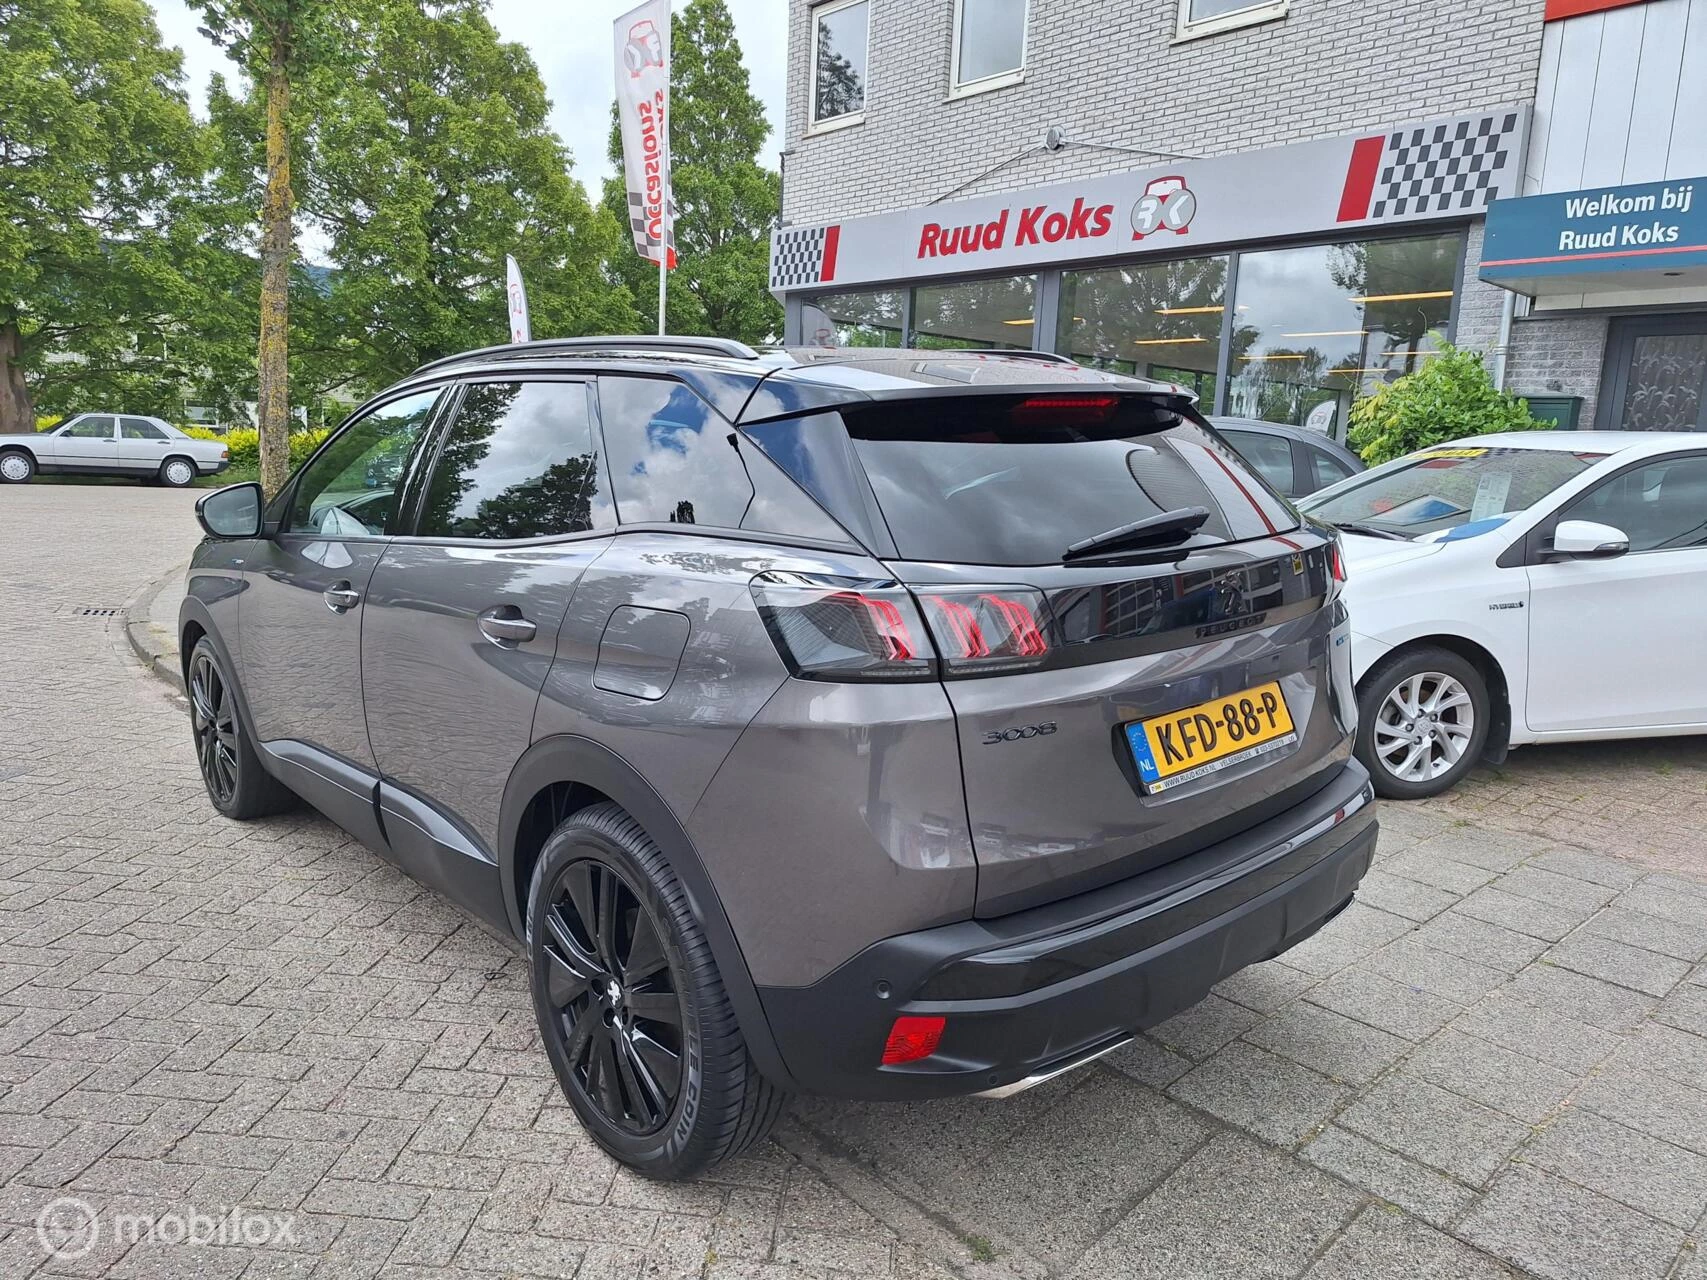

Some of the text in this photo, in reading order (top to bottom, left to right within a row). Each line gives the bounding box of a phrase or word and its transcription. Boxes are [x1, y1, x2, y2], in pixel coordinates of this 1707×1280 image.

[1565, 185, 1694, 219] Welkom bij
[917, 197, 1115, 259] Ruud Koks
[1558, 221, 1680, 251] Ruud Koks
[1199, 614, 1266, 637] PEUGEOT
[982, 721, 1057, 745] 3008
[1155, 691, 1278, 766] KFD-88-P
[1140, 759, 1155, 773] NL
